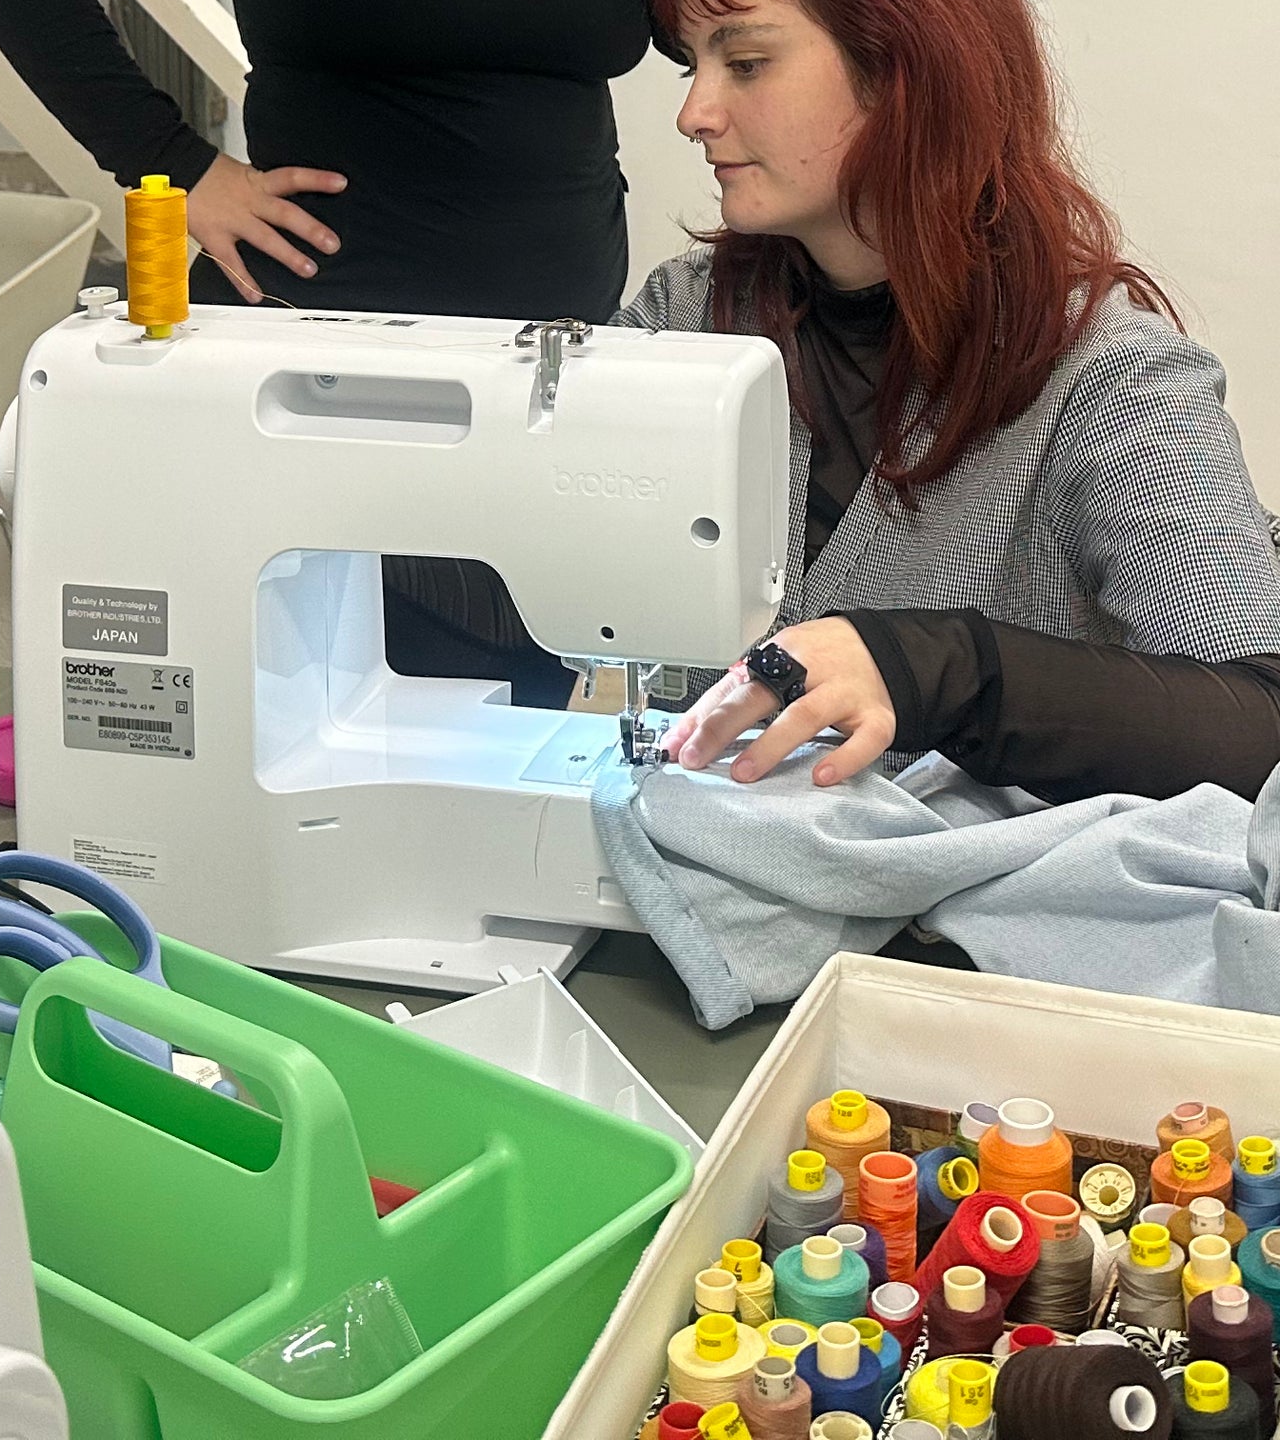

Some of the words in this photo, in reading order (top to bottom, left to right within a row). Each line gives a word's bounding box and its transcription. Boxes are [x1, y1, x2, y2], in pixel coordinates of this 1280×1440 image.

[552, 464, 667, 501] brother
[72, 596, 97, 607] Quality
[99, 598, 104, 606] &
[106, 598, 147, 611] Technology
[148, 602, 158, 612] by
[67, 609, 102, 620] BROTHER
[92, 628, 138, 644] JAPAN
[66, 661, 115, 677] brother
[66, 676, 93, 686] MODEL
[66, 683, 88, 692] Product
[89, 685, 103, 693] Code
[130, 742, 145, 750] MADE
[155, 745, 180, 753] VIETNAM
[960, 1386, 985, 1398] 261
